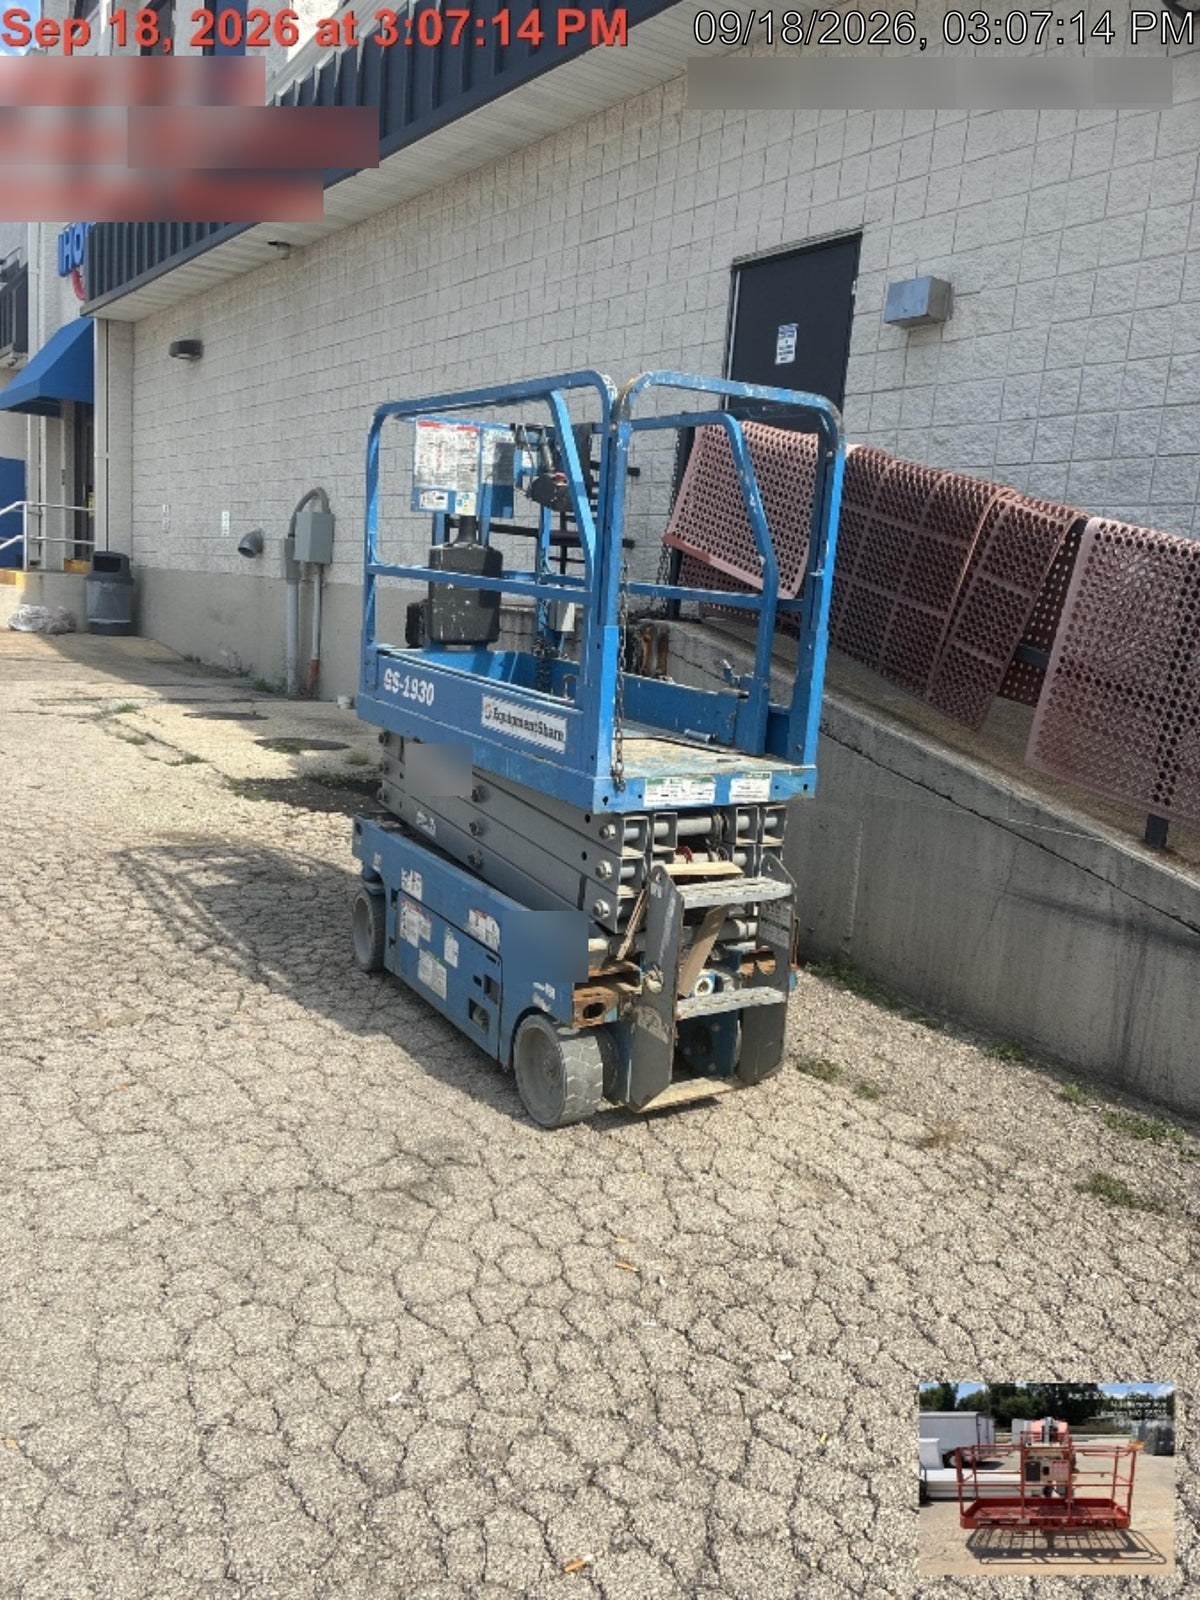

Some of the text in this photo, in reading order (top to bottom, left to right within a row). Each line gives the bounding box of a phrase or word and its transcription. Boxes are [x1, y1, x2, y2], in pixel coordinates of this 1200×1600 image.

[57, 222, 96, 277] IHO
[384, 668, 434, 706] GS-1930
[493, 707, 564, 741] EquipmentShare
